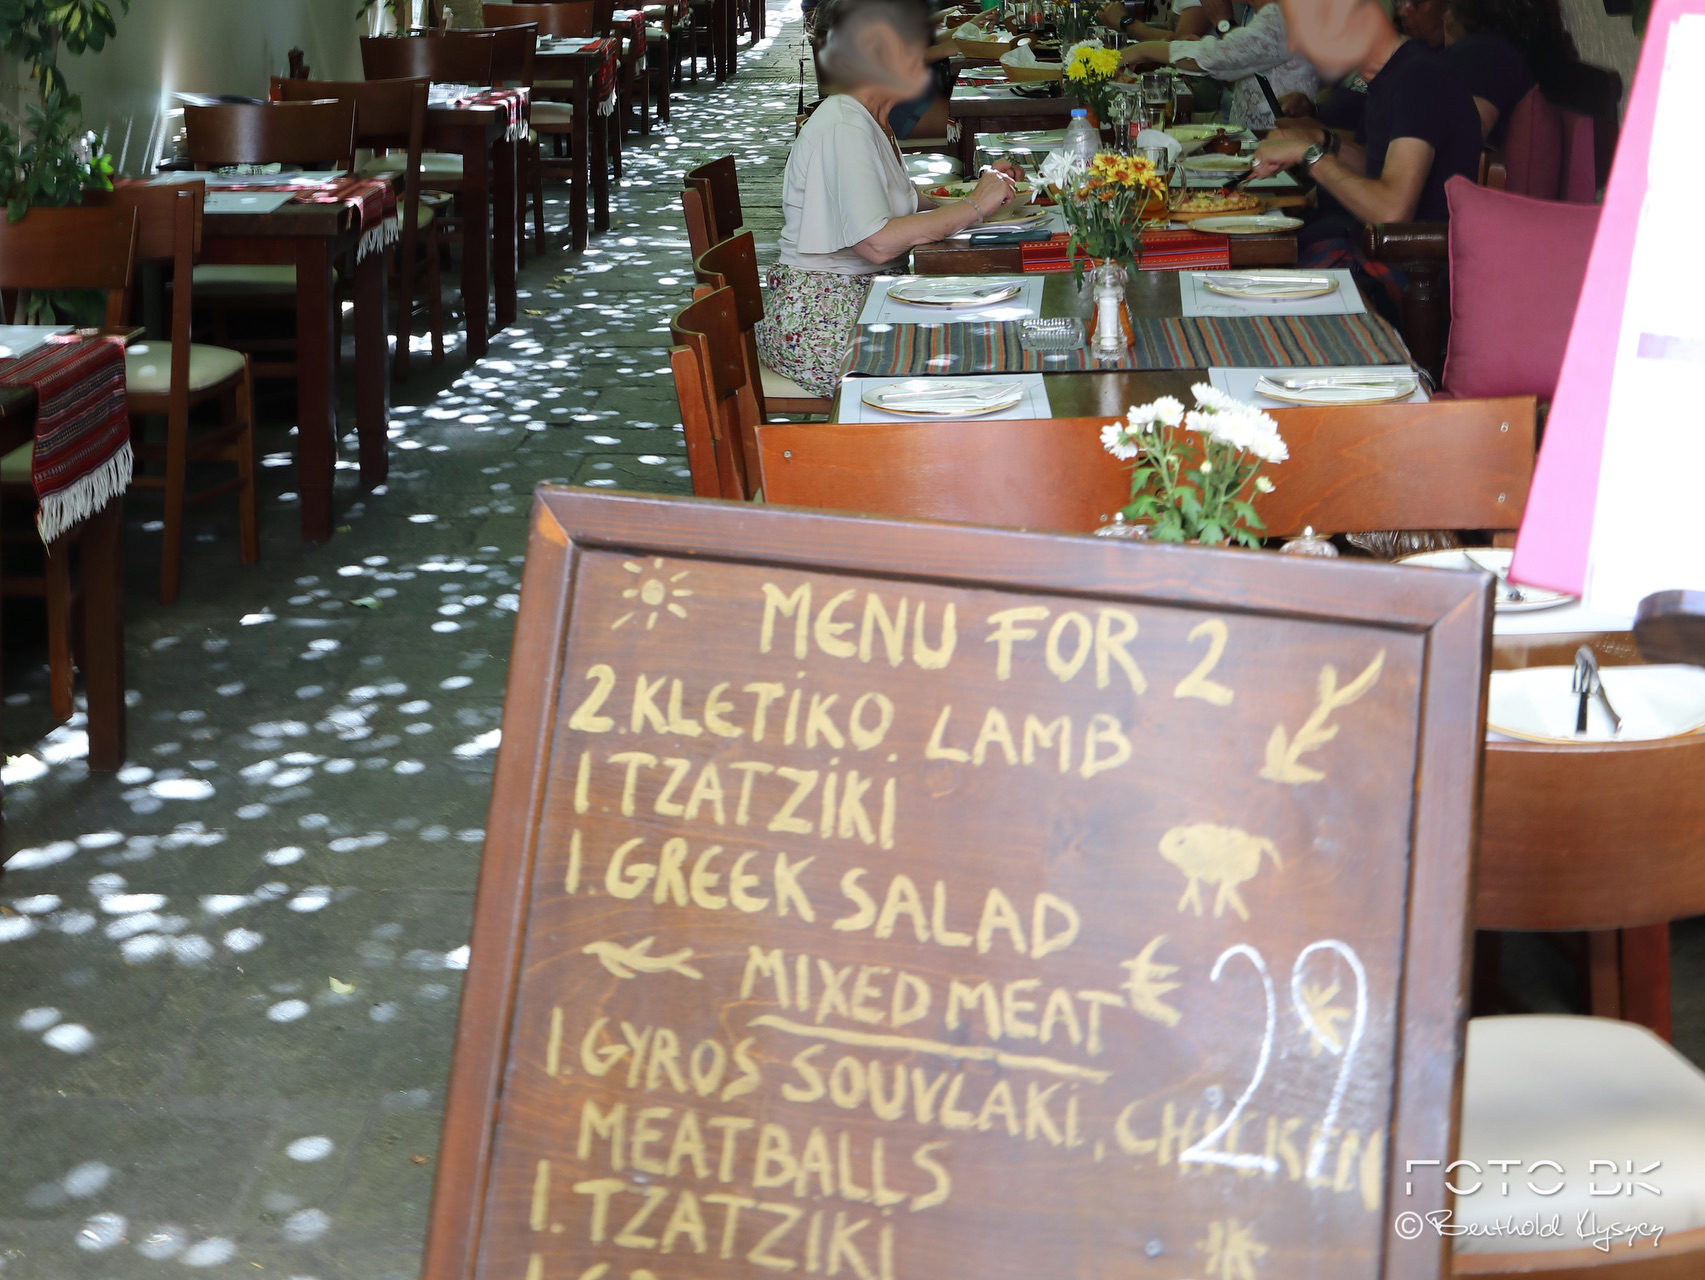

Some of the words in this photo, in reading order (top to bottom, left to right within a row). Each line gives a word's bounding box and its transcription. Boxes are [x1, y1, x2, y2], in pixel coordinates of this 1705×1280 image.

[758, 583, 957, 670] MENU
[985, 605, 1146, 694] FOR
[1174, 620, 1234, 706] 2
[926, 705, 1133, 778] LAMB
[832, 868, 1080, 958] SALAD
[741, 945, 932, 1025] MIXED
[944, 978, 1126, 1054] MEAT
[1178, 938, 1369, 1179] 29
[578, 1101, 952, 1211] MEATBALLS
